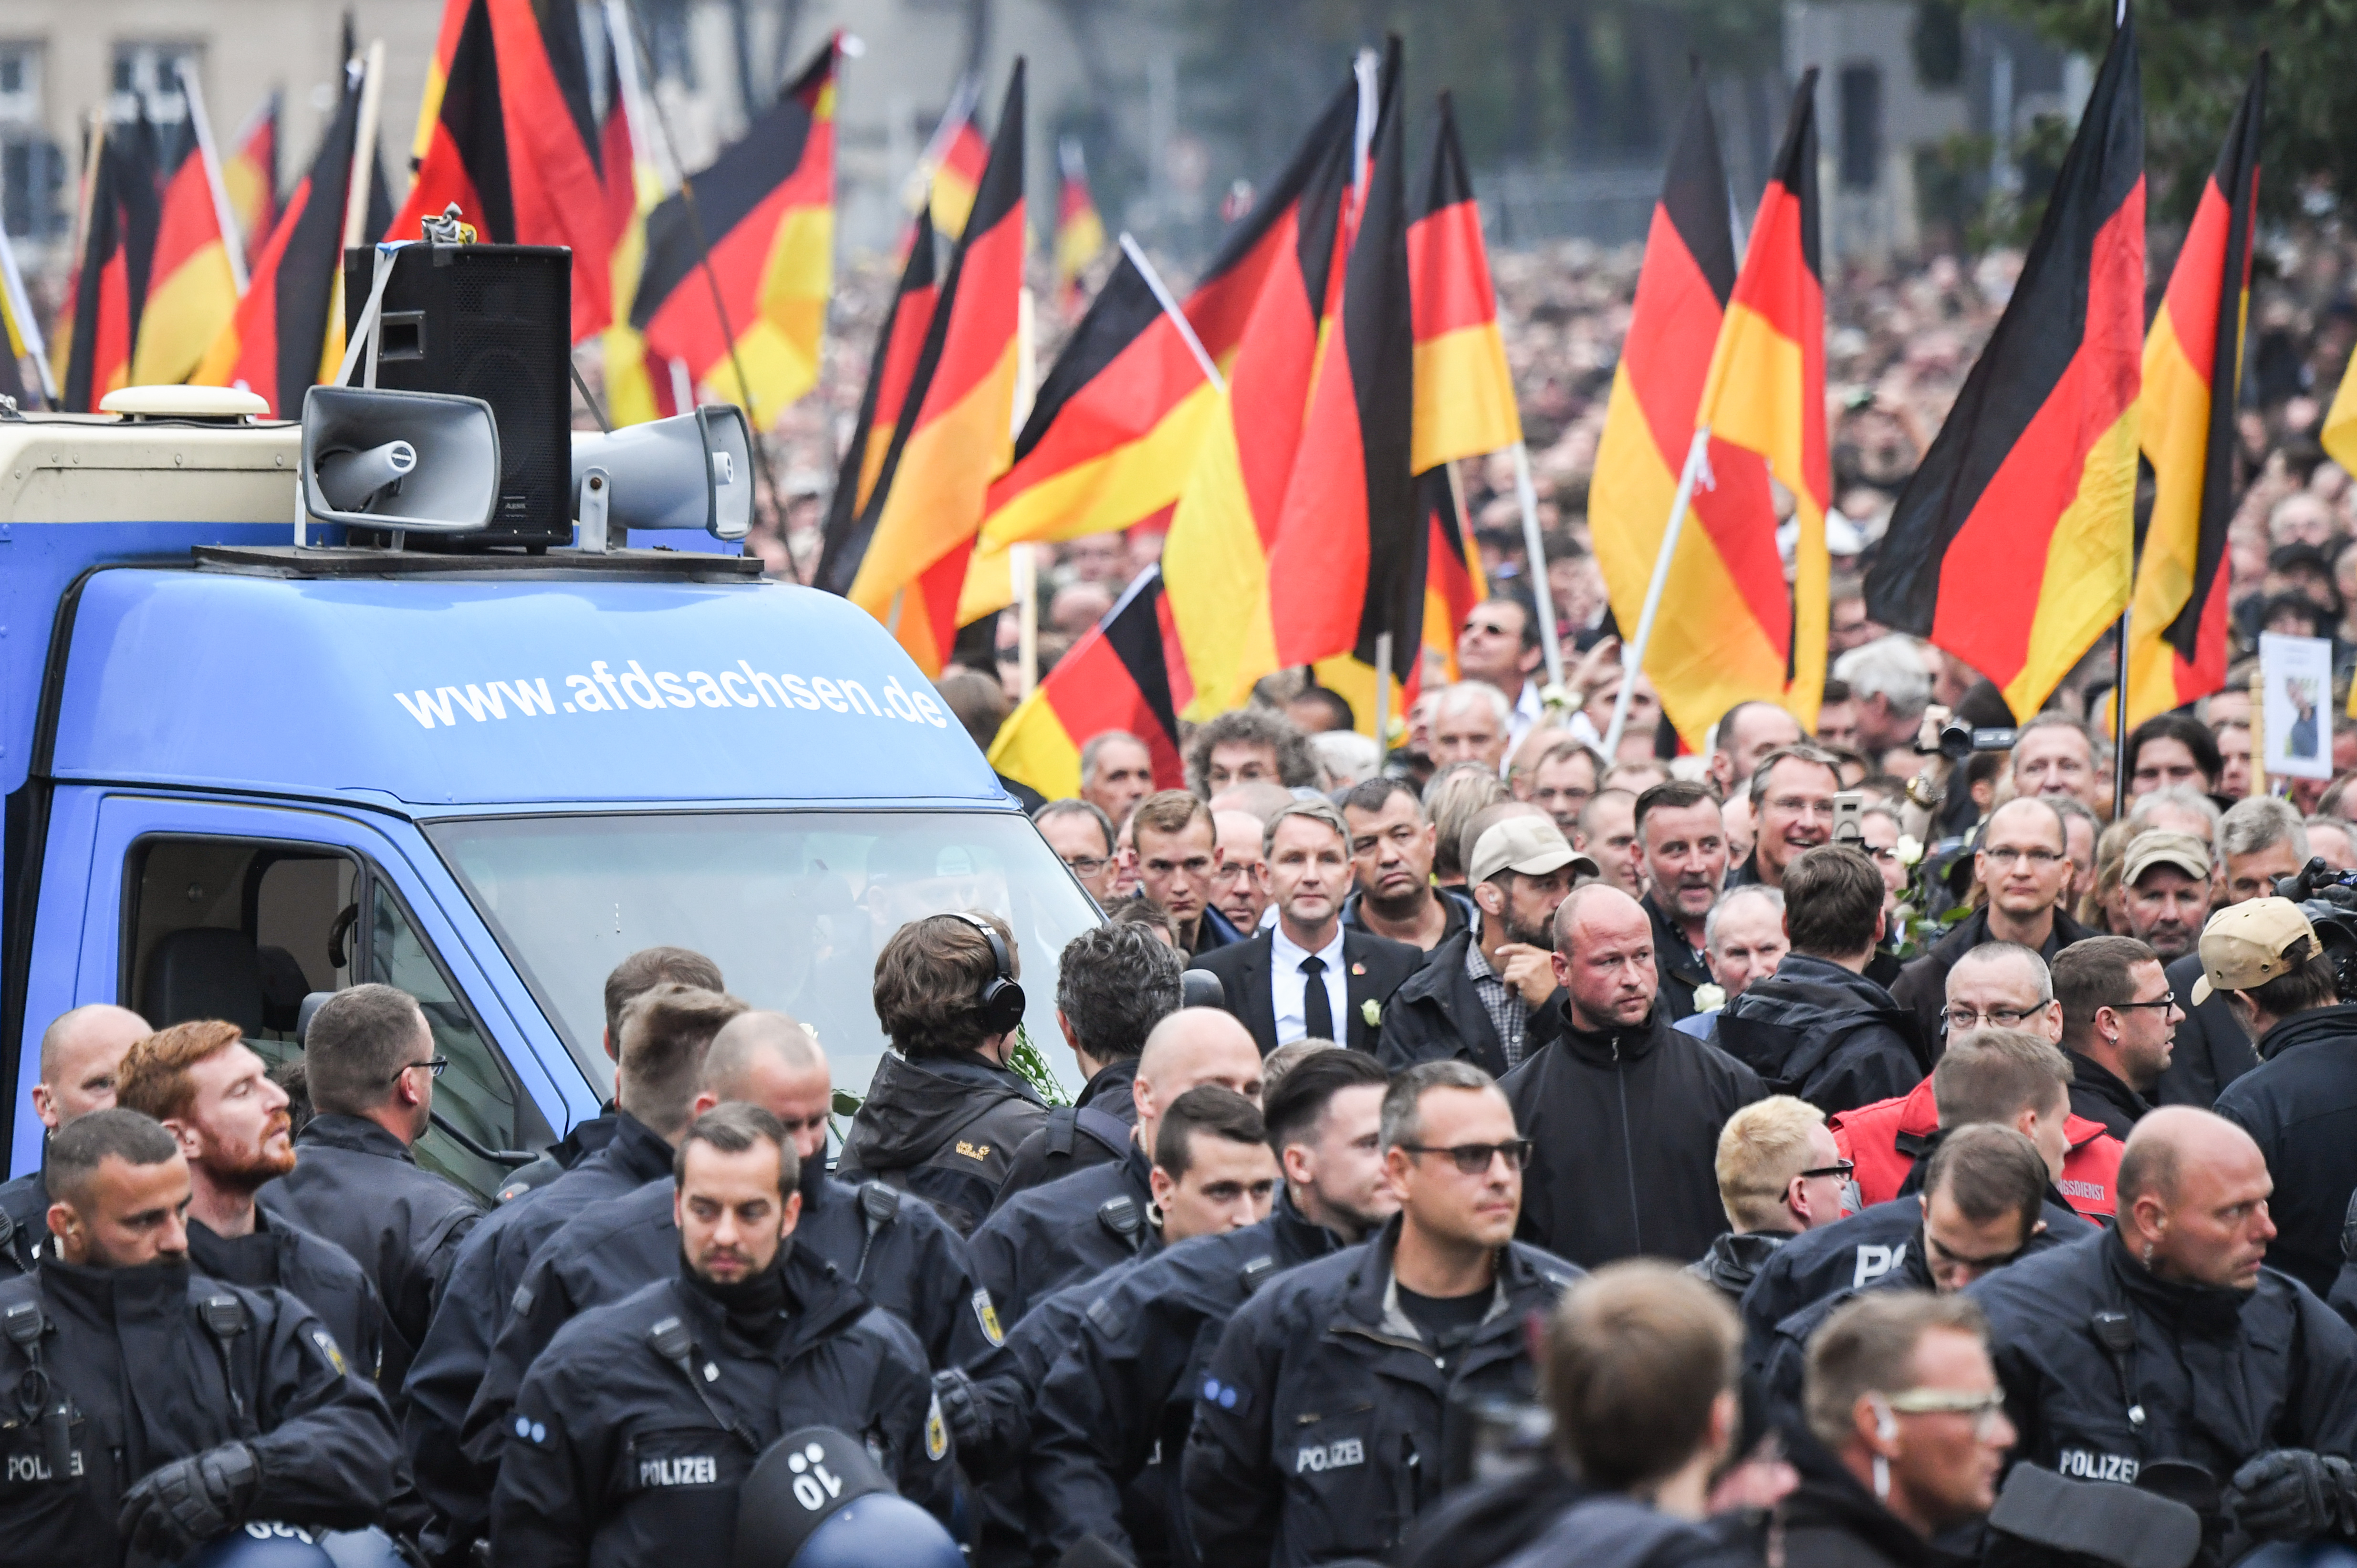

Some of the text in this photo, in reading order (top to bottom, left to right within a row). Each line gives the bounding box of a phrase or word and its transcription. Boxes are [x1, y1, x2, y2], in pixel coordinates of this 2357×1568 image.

[394, 660, 948, 729] www.afdsachsen.de
[956, 1146, 984, 1162] Wolfskin
[640, 1456, 717, 1487] POLIZEI
